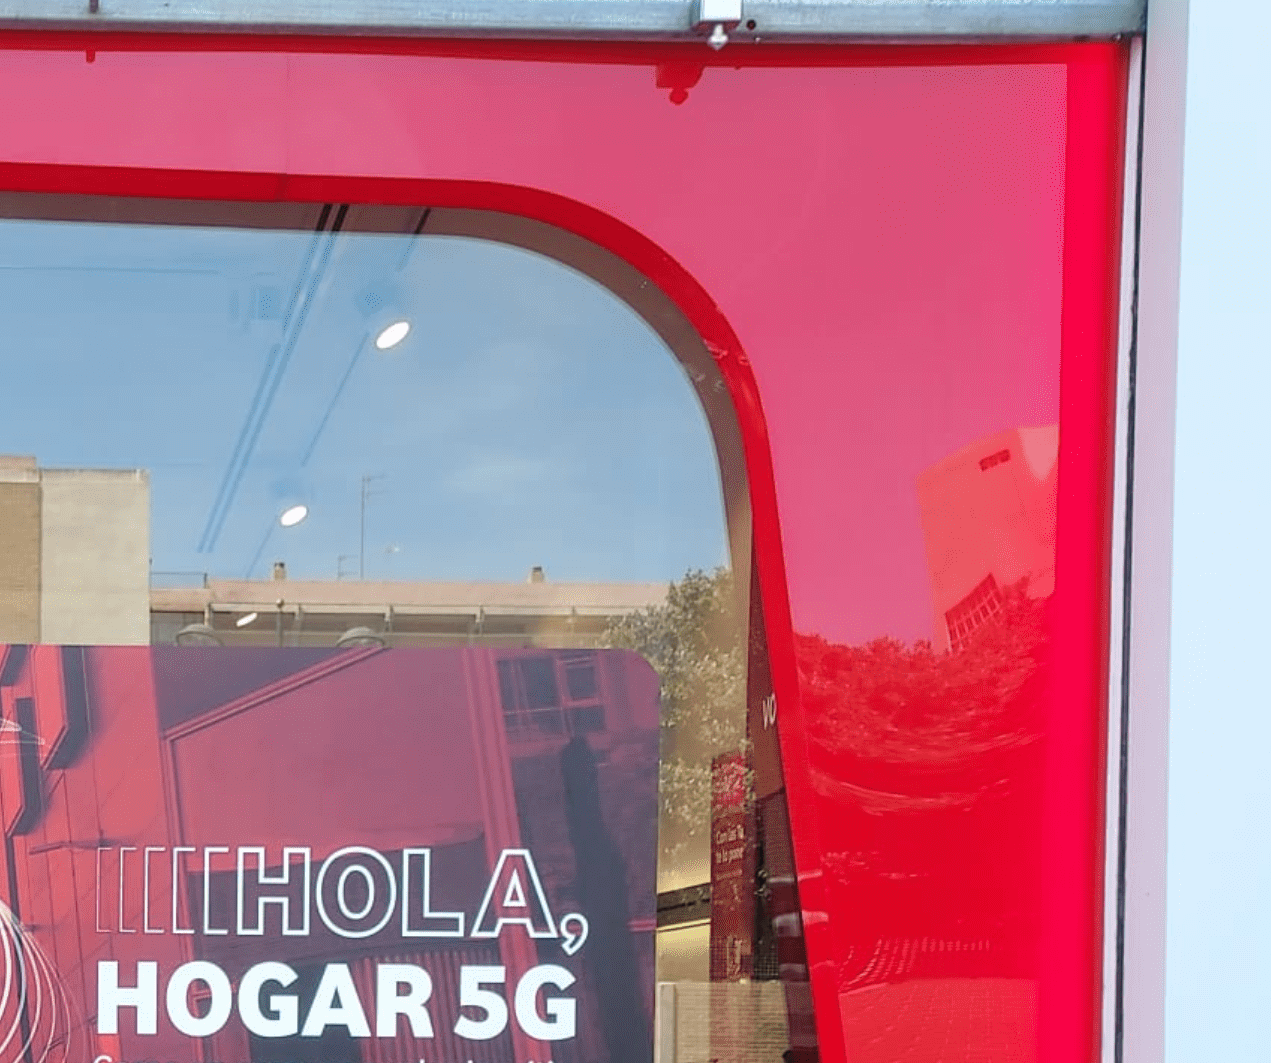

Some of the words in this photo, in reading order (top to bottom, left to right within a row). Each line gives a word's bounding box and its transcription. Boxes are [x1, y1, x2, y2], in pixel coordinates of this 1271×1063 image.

[237, 846, 589, 955] HOLA,
[96, 959, 435, 1040] HOGAR
[452, 963, 578, 1041] 5G
